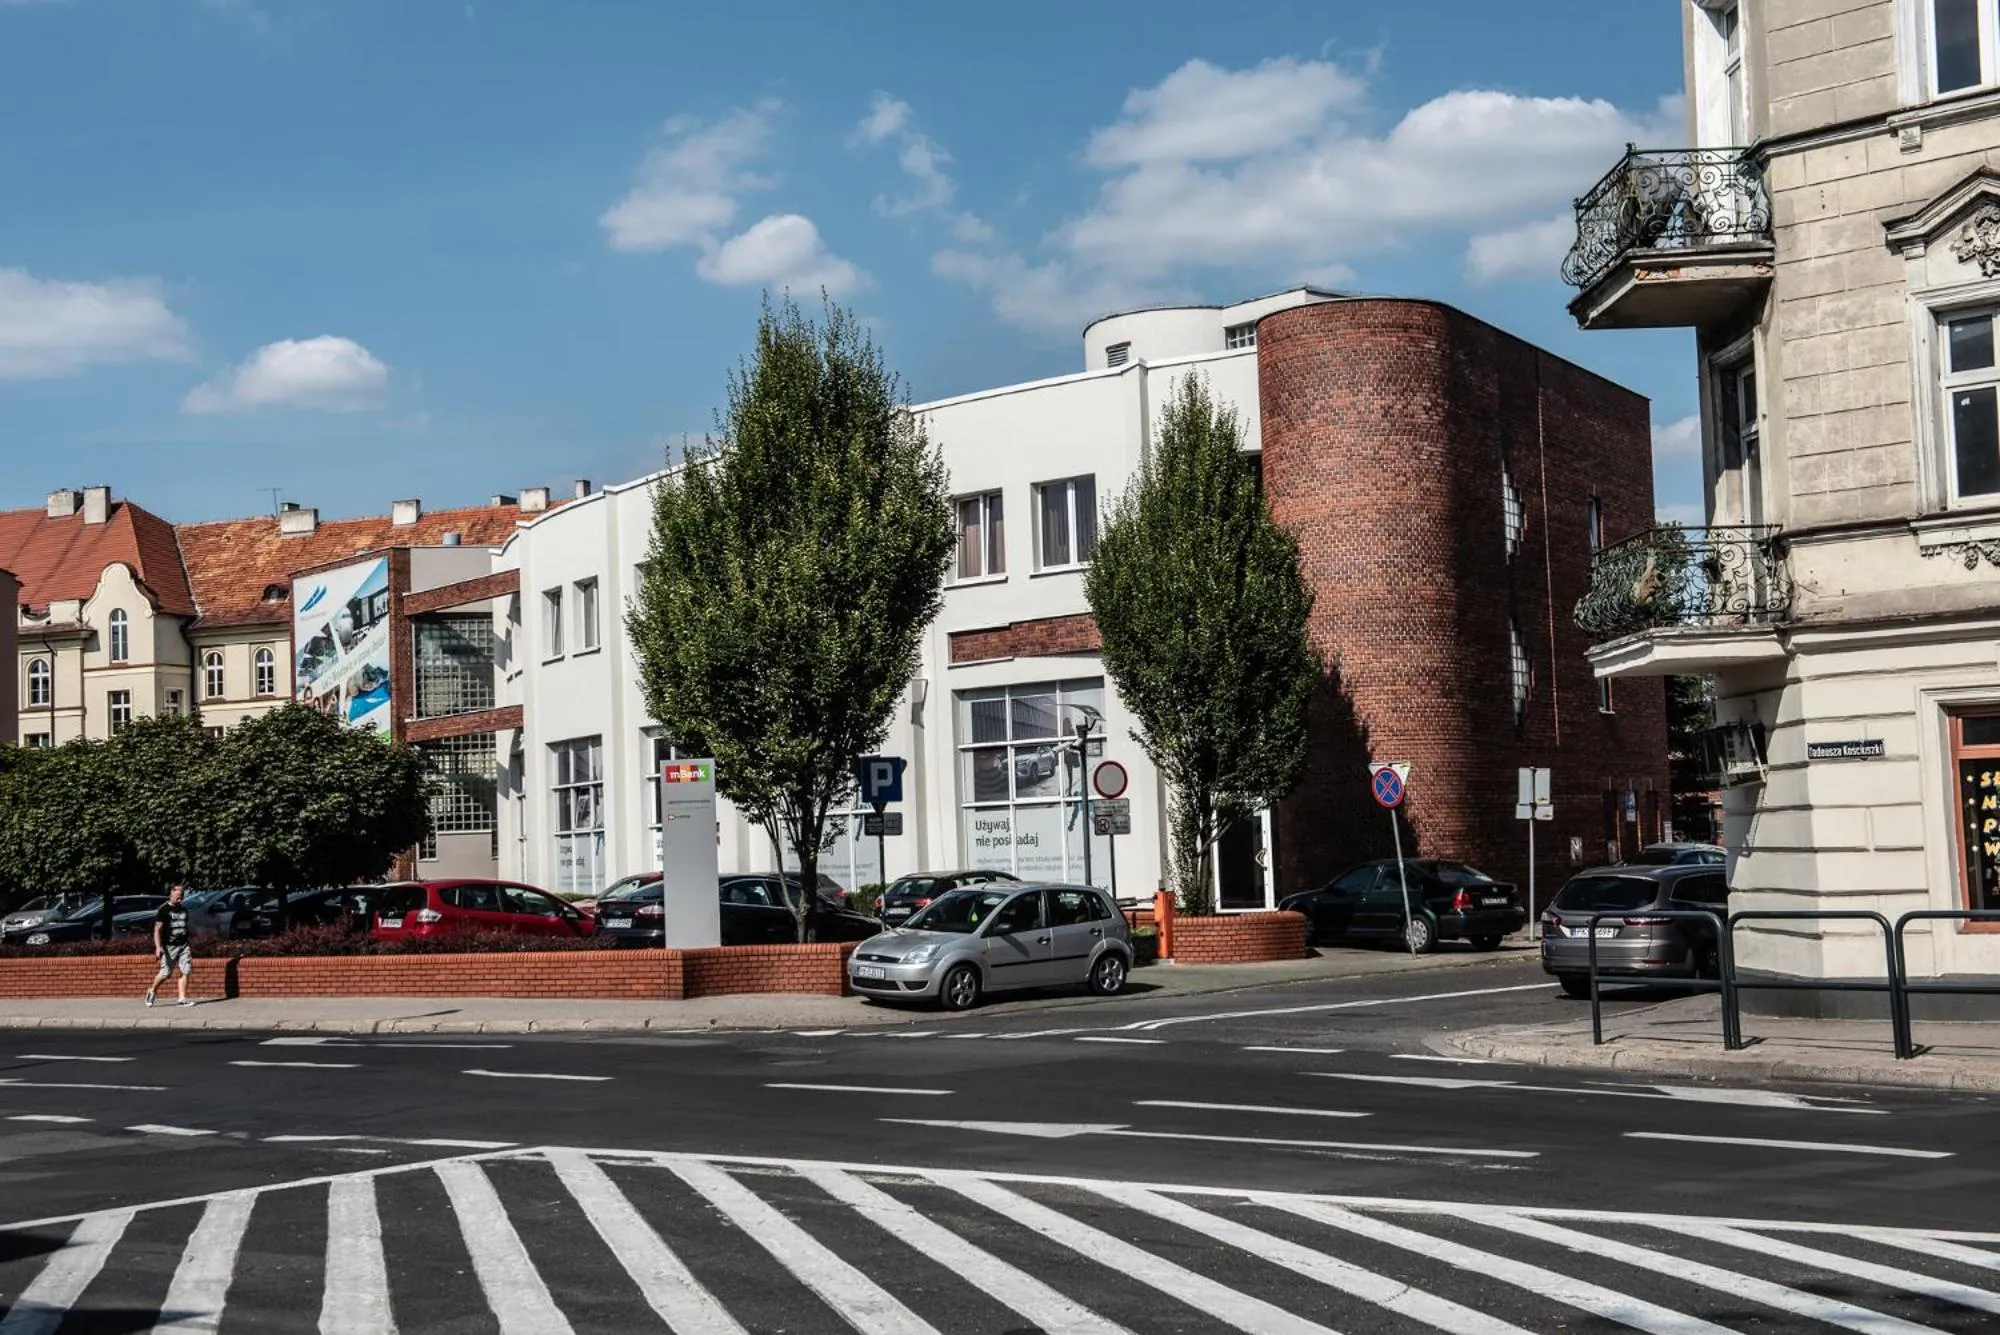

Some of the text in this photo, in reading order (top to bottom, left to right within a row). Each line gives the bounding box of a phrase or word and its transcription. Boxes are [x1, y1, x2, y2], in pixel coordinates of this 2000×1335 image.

[669, 768, 706, 779] mBank
[870, 762, 894, 797] P
[975, 817, 1010, 833] Używaj
[975, 835, 990, 848] nie
